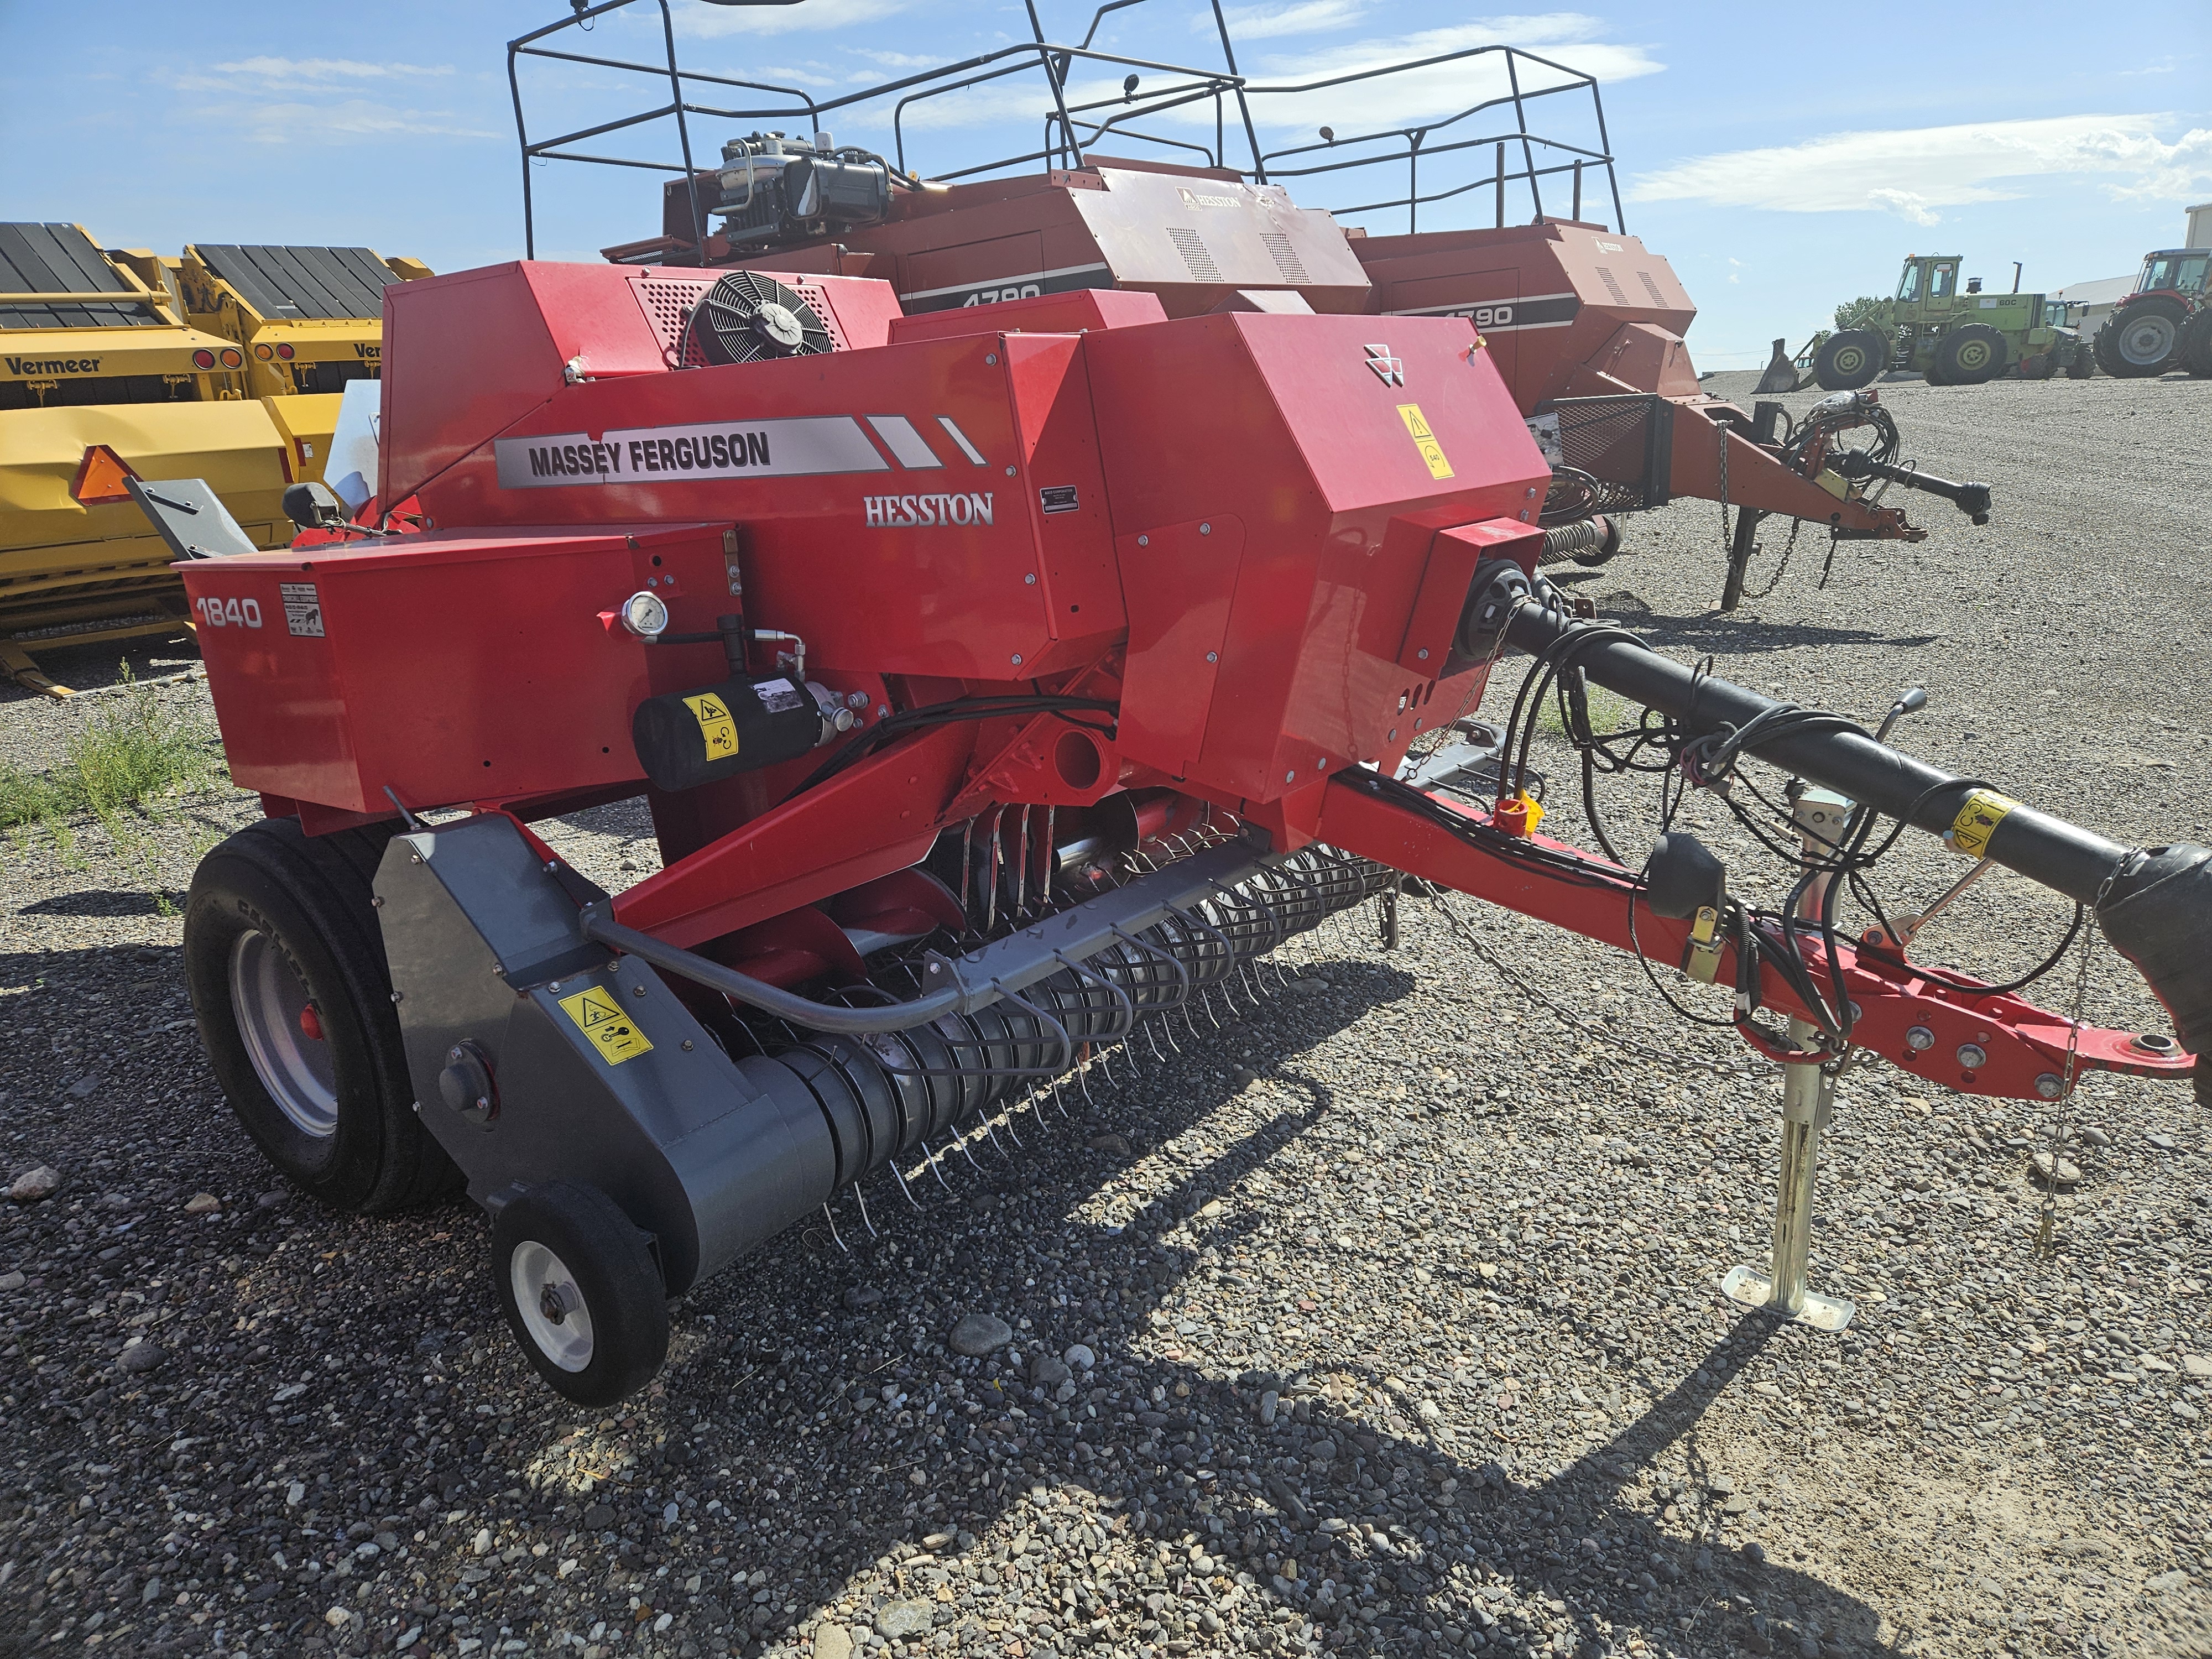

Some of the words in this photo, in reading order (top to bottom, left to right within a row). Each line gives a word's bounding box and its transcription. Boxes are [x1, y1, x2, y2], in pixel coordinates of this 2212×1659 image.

[1196, 195, 1241, 207] HESSTON
[4, 357, 100, 375] Vermeer
[528, 442, 621, 477] MASSEY
[628, 432, 771, 472] FERGUSON
[863, 492, 994, 527] HESSTON
[196, 597, 263, 628] 1840
